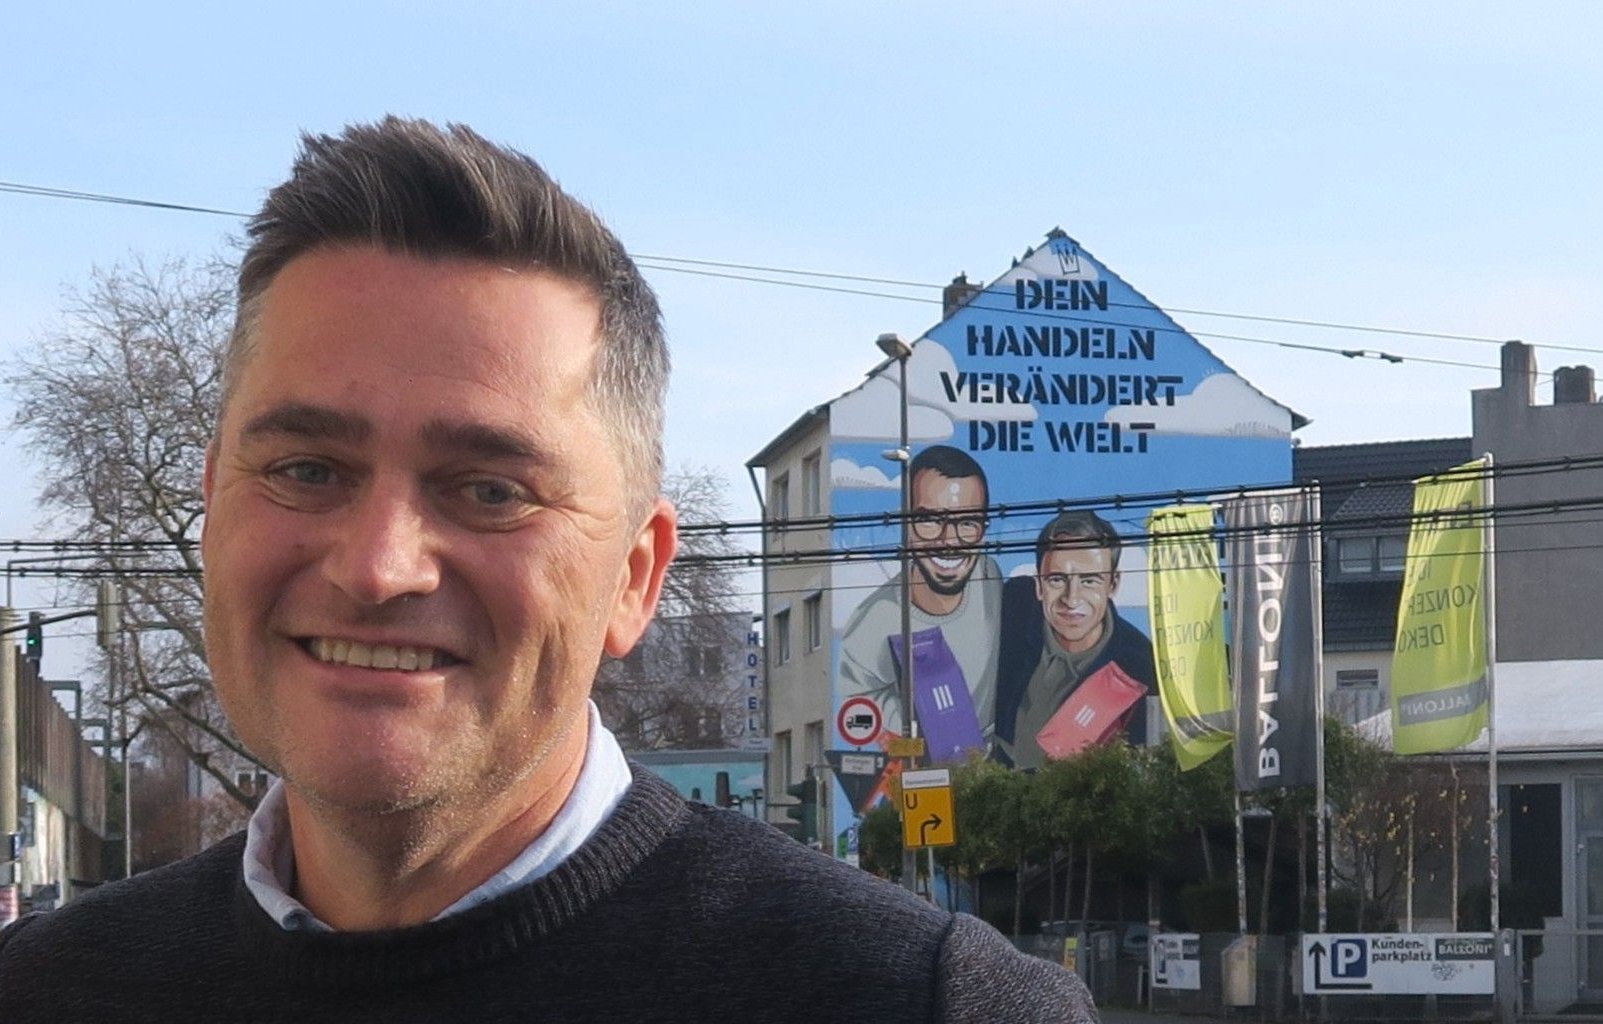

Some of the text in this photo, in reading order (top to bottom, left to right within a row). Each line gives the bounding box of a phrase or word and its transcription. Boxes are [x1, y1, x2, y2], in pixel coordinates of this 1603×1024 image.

[1015, 279, 1108, 311] DEIN
[967, 324, 1155, 360] HANDELN
[939, 366, 1183, 406] VERÄNDERT
[969, 420, 1156, 453] DIE WELT
[747, 632, 759, 731] HOTEL
[905, 793, 918, 810] U
[1337, 942, 1361, 974] P
[1372, 937, 1424, 949] Kunden-
[1372, 950, 1433, 962] parkplatz
